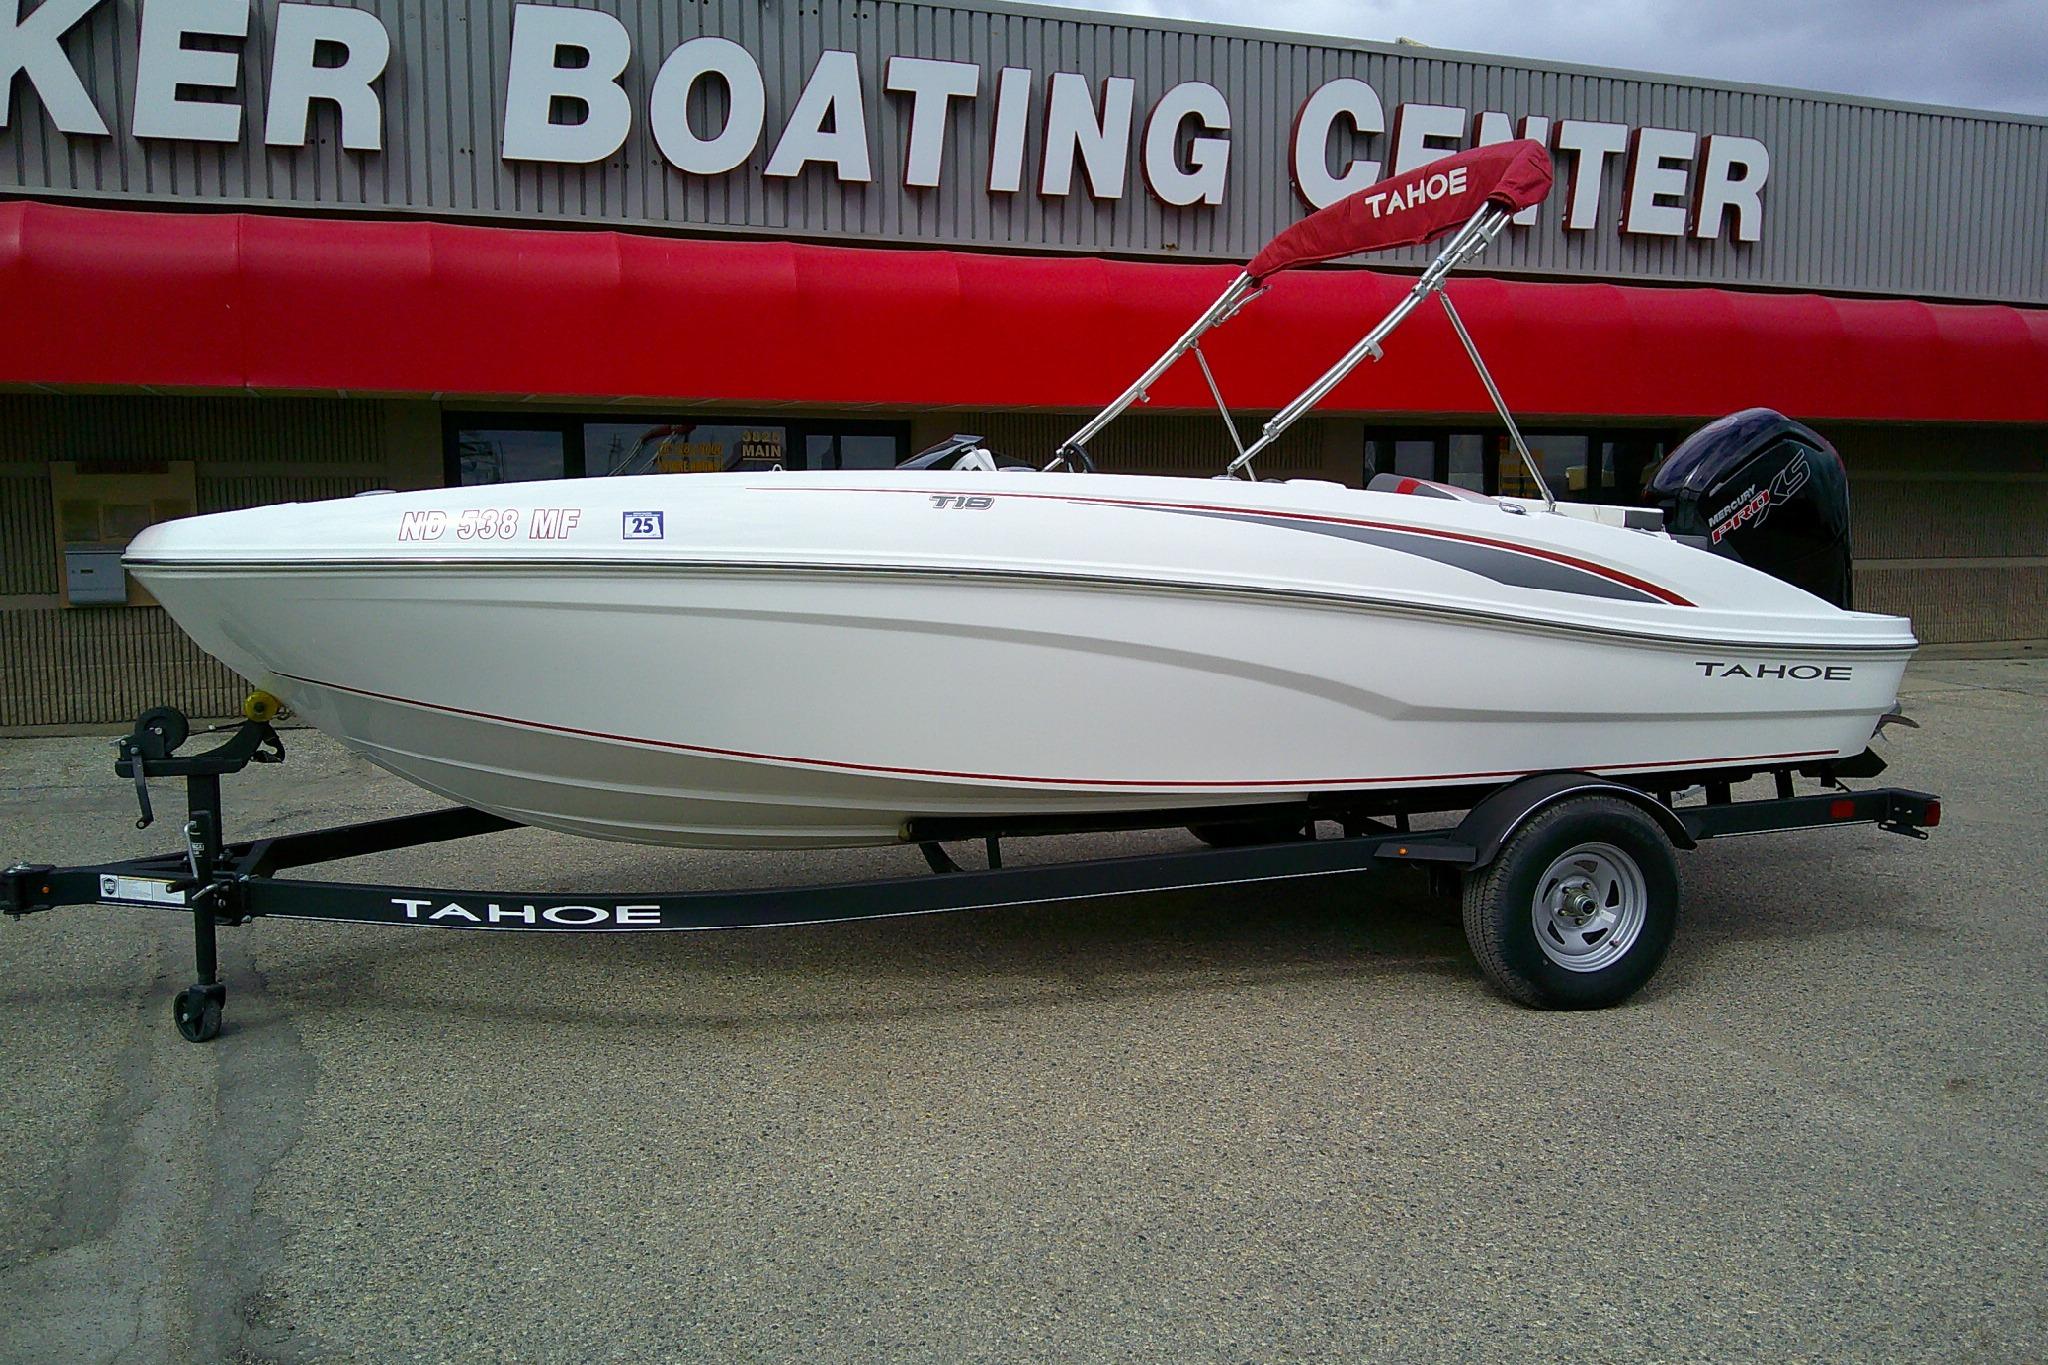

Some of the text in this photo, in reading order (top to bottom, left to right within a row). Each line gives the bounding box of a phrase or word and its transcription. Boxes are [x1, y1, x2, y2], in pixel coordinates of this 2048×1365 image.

[0, 0, 390, 151] KER
[502, 3, 1231, 206] BOATING
[1365, 167, 1467, 218] TAHOE
[742, 444, 782, 457] MAIN
[929, 495, 995, 511] T18
[1708, 483, 1756, 528] MERCURY
[398, 509, 582, 541] ND 538 MF
[632, 517, 655, 534] 25
[1695, 661, 1853, 681] TAHOE
[391, 898, 661, 925] TAHOE
